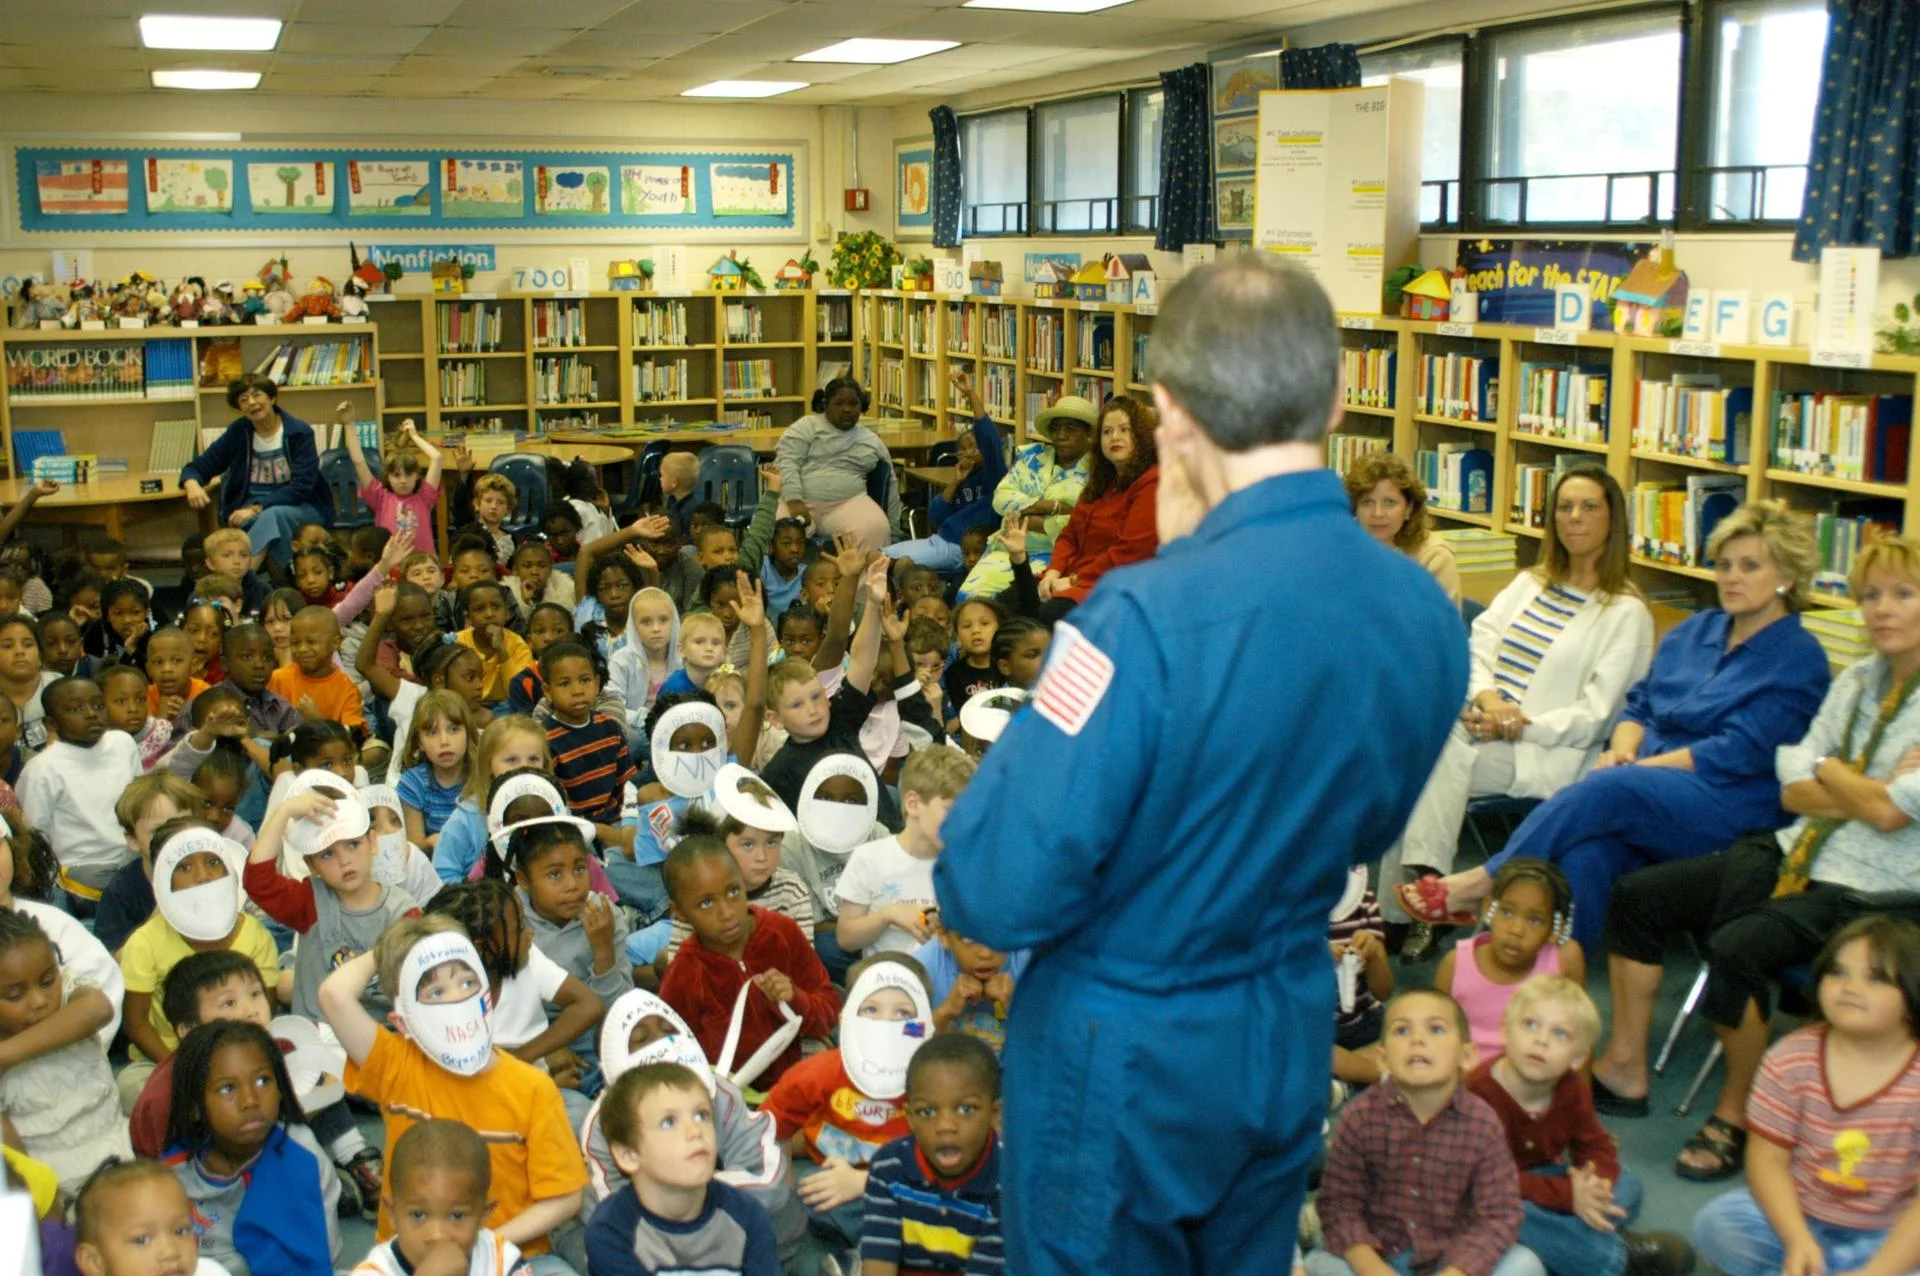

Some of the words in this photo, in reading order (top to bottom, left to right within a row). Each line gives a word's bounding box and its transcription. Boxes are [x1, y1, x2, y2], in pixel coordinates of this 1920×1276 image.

[1135, 276, 1151, 300] A
[1508, 259, 1540, 289] for
[1543, 263, 1572, 291] the
[1561, 291, 1584, 323] D
[1686, 297, 1704, 333] E
[1716, 299, 1741, 335] F
[1763, 299, 1789, 338] G
[8, 349, 81, 368] WORLD
[84, 347, 142, 367] BOOK
[445, 1019, 480, 1044] NASA
